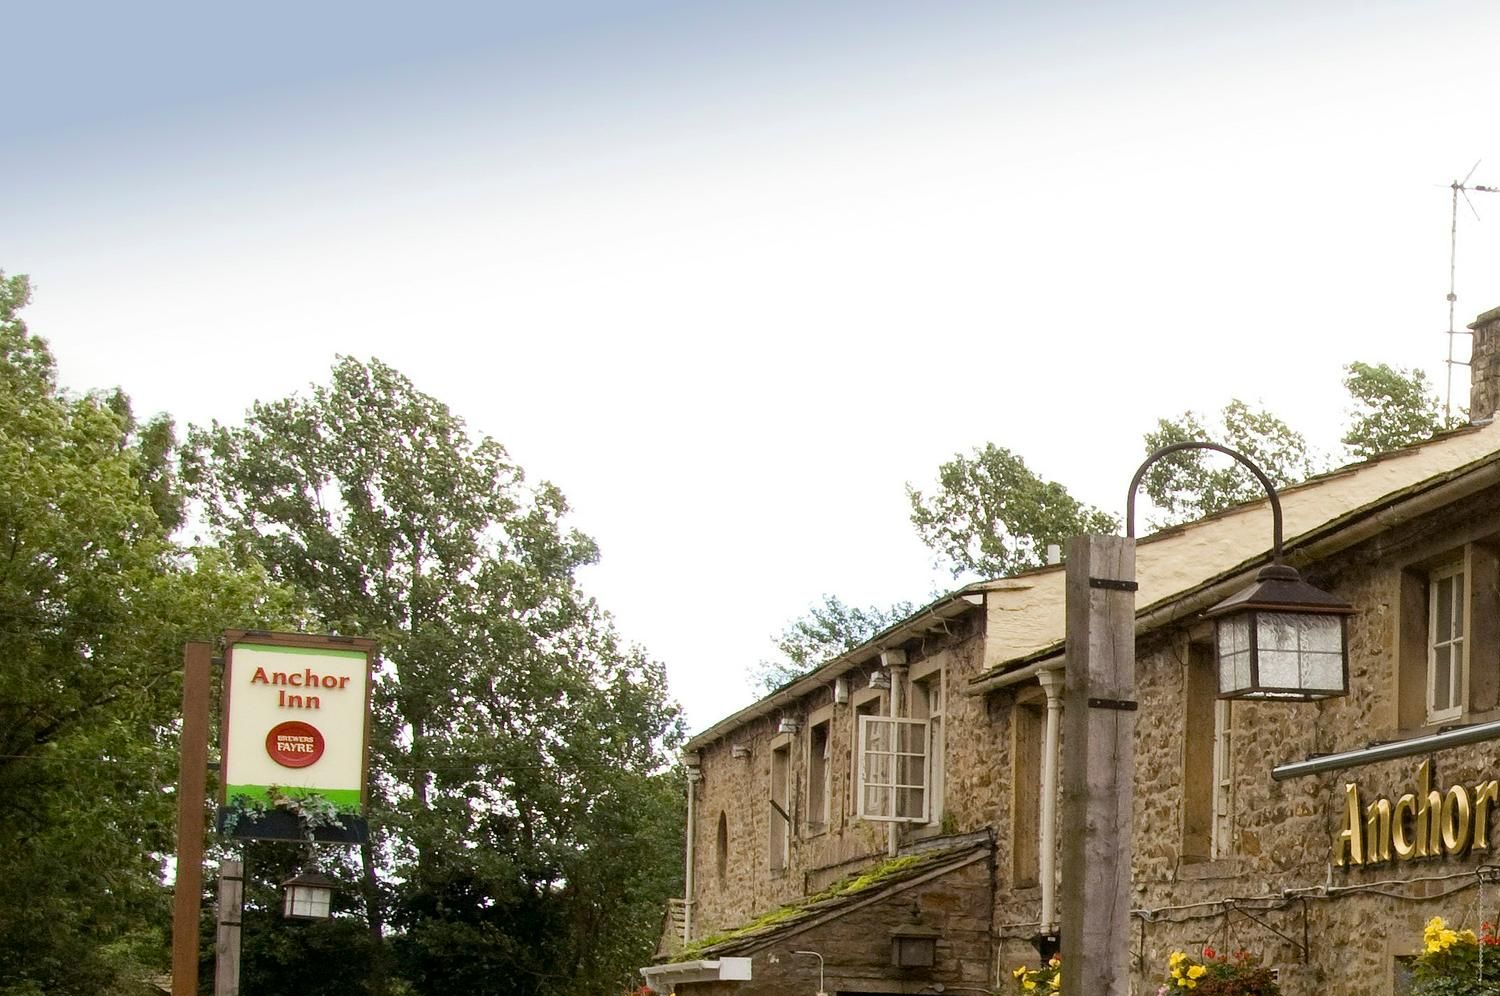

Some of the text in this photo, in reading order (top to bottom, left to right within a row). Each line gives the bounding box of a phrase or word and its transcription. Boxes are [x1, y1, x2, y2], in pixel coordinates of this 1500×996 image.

[251, 666, 350, 689] Anchor
[279, 690, 320, 709] Inn
[277, 742, 314, 753] FAYRE
[1332, 758, 1499, 866] Anchor
